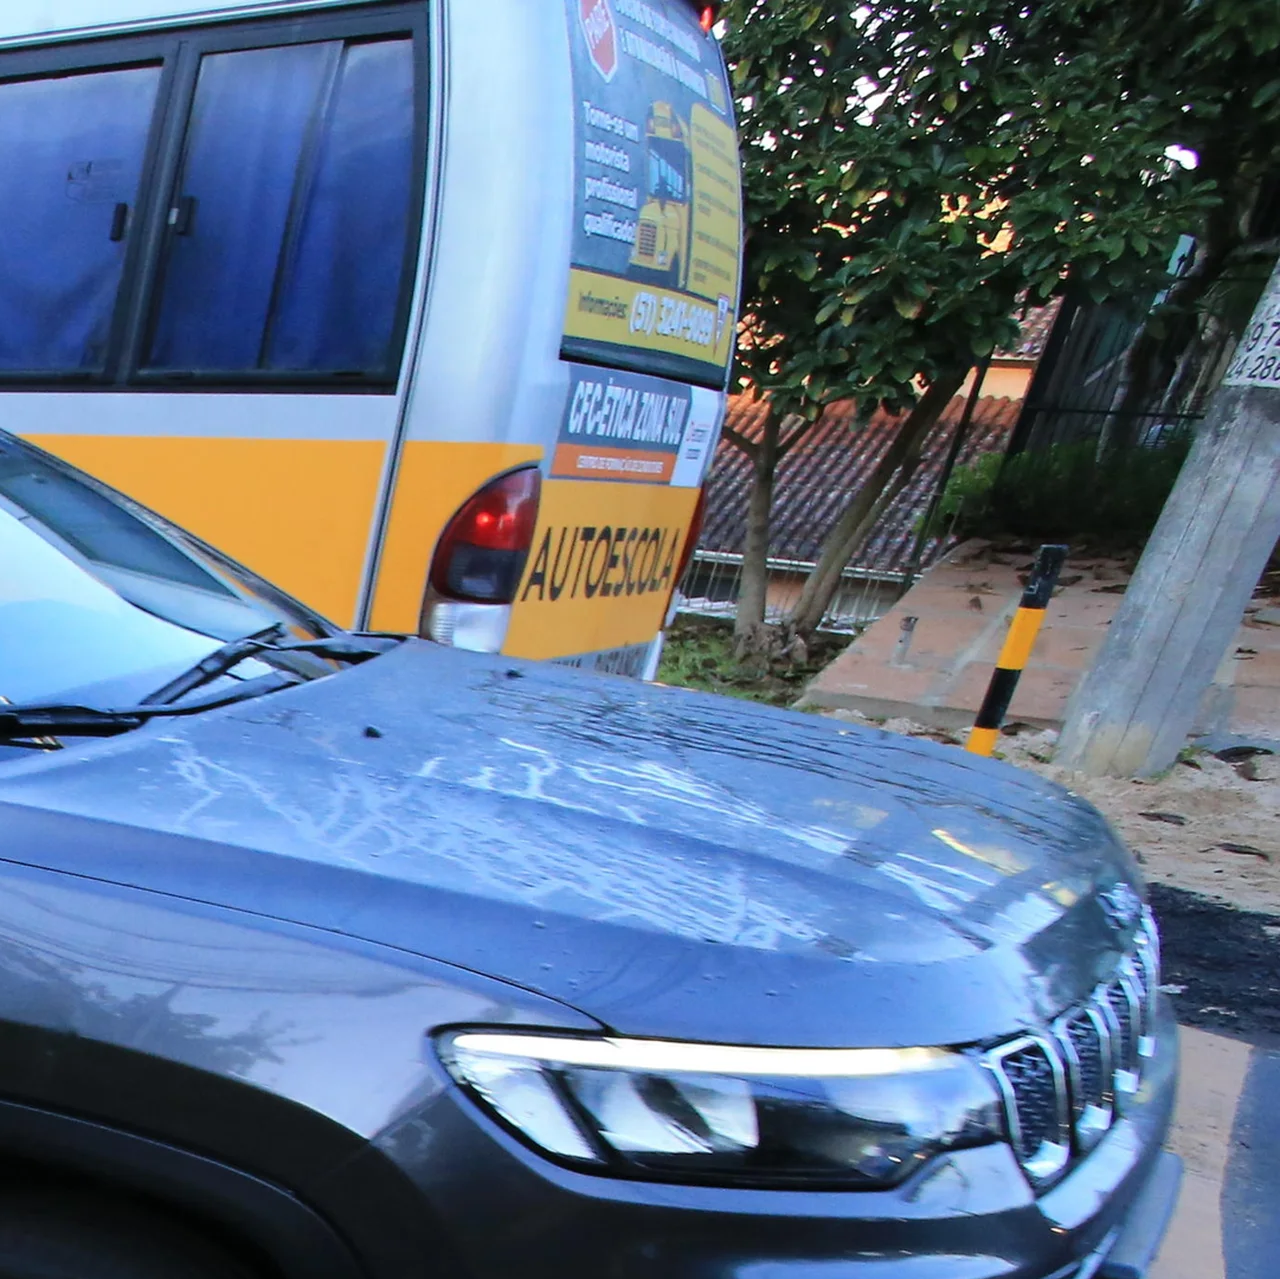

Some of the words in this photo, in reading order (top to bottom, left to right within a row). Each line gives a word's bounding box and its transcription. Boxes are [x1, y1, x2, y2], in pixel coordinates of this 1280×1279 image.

[633, 389, 672, 443] ZONA
[663, 395, 688, 444] SUL
[522, 525, 680, 602] AUTOESCOLA
